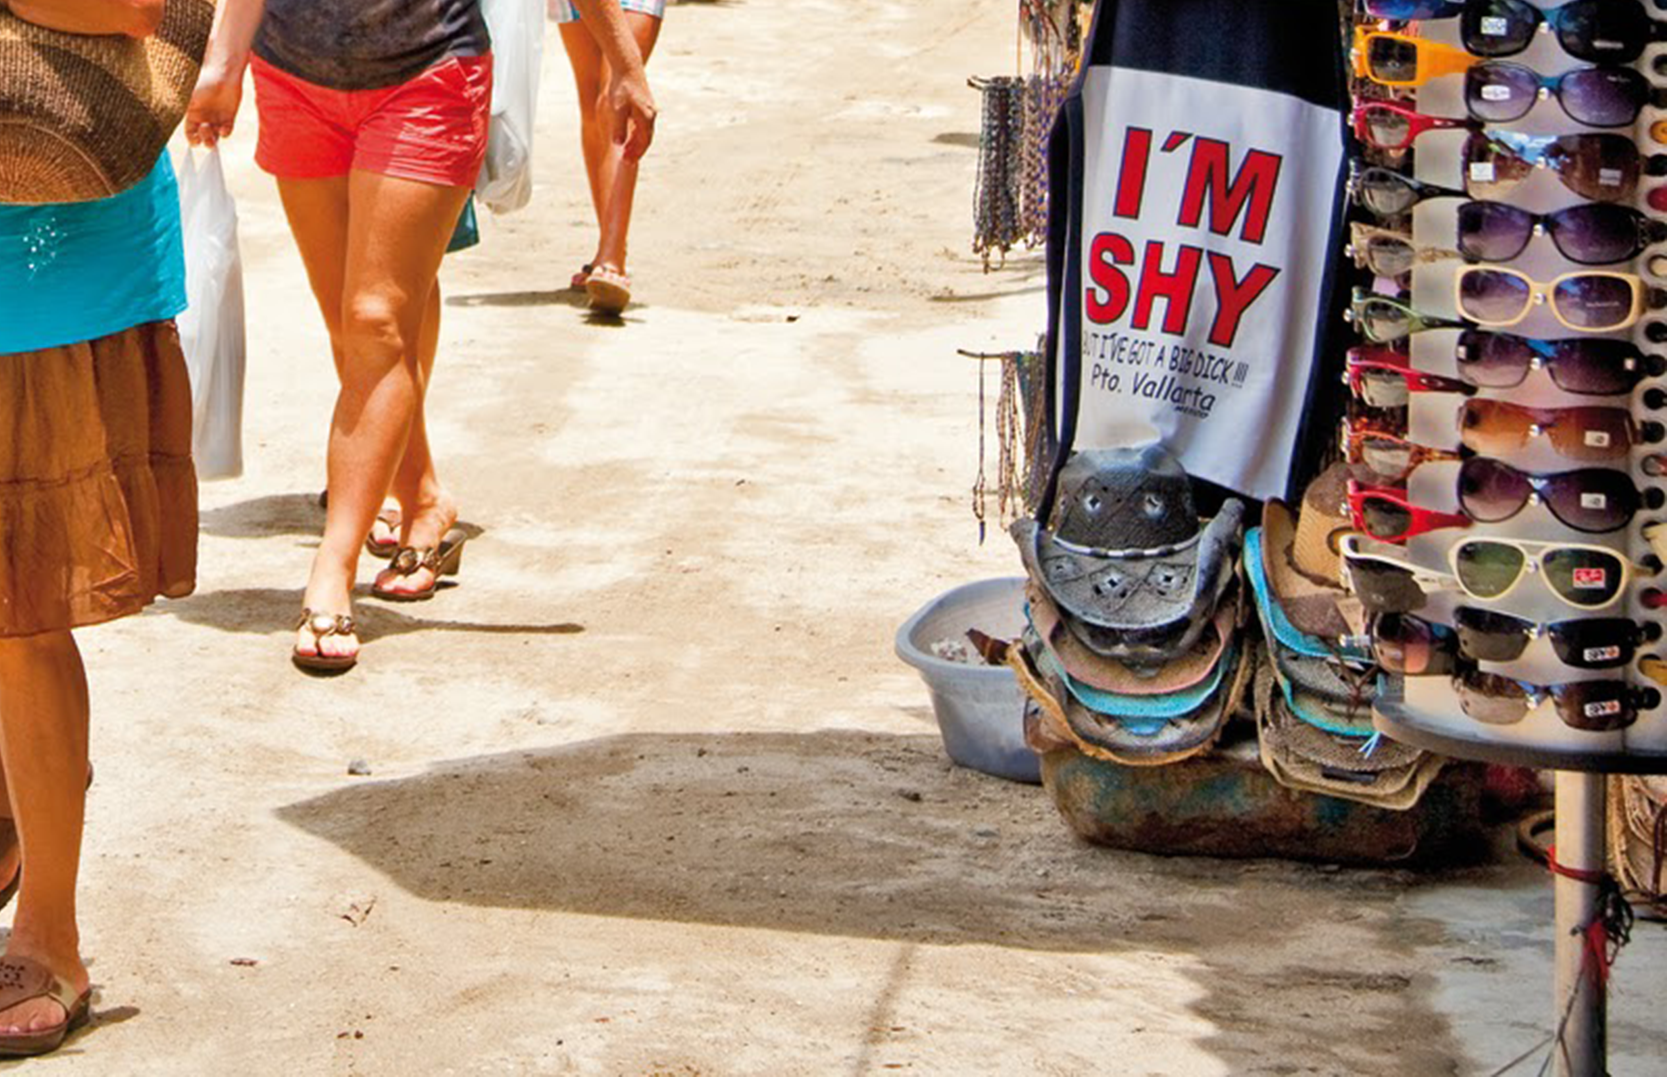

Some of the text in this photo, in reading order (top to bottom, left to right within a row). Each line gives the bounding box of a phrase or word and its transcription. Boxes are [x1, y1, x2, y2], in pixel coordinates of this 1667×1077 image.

[1085, 231, 1282, 349] SHY
[1127, 339, 1155, 366] GOT
[1154, 345, 1166, 368] A
[1168, 345, 1195, 375] BIG
[1193, 351, 1235, 385] DICK
[1091, 363, 1217, 412] Pto. Vallarta
